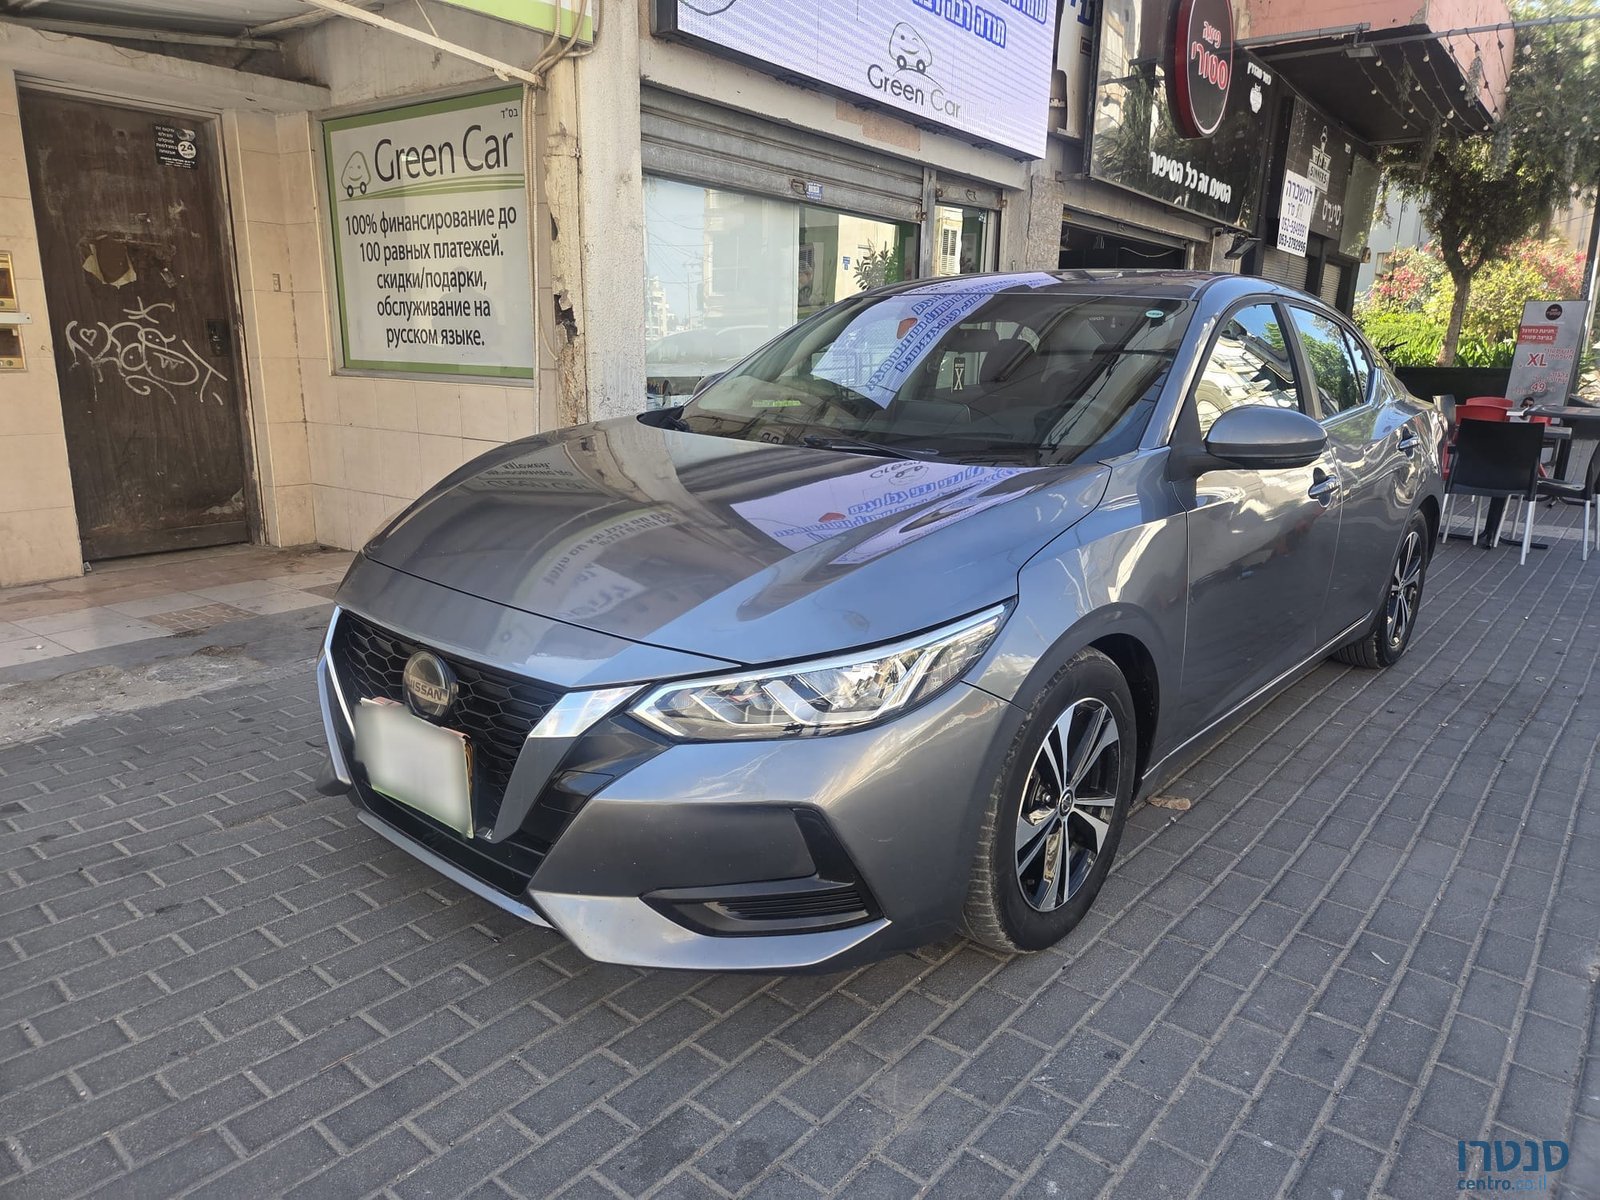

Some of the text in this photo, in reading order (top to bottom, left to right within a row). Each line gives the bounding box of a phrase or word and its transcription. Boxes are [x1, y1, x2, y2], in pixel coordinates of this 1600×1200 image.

[974, 5, 1006, 48] תודה
[1202, 21, 1221, 48] פיצה
[1191, 41, 1228, 90] סטורי
[867, 64, 961, 118] Green Car
[501, 107, 519, 119] בס"ד
[180, 143, 194, 152] 24
[374, 124, 514, 182] Green Car
[1150, 151, 1184, 184] הסיפור
[1185, 161, 1198, 190] כל
[1285, 180, 1313, 206] להשכרה
[345, 206, 517, 239] 100% финансирование до
[360, 233, 504, 266] 100 равных платежей.
[377, 267, 487, 293] скидки/подарки,
[377, 296, 491, 322] обслуживание на
[386, 327, 485, 348] русском языке.
[1527, 353, 1547, 367] XL
[1531, 380, 1547, 393] 49
[409, 678, 442, 701] NISSAN
